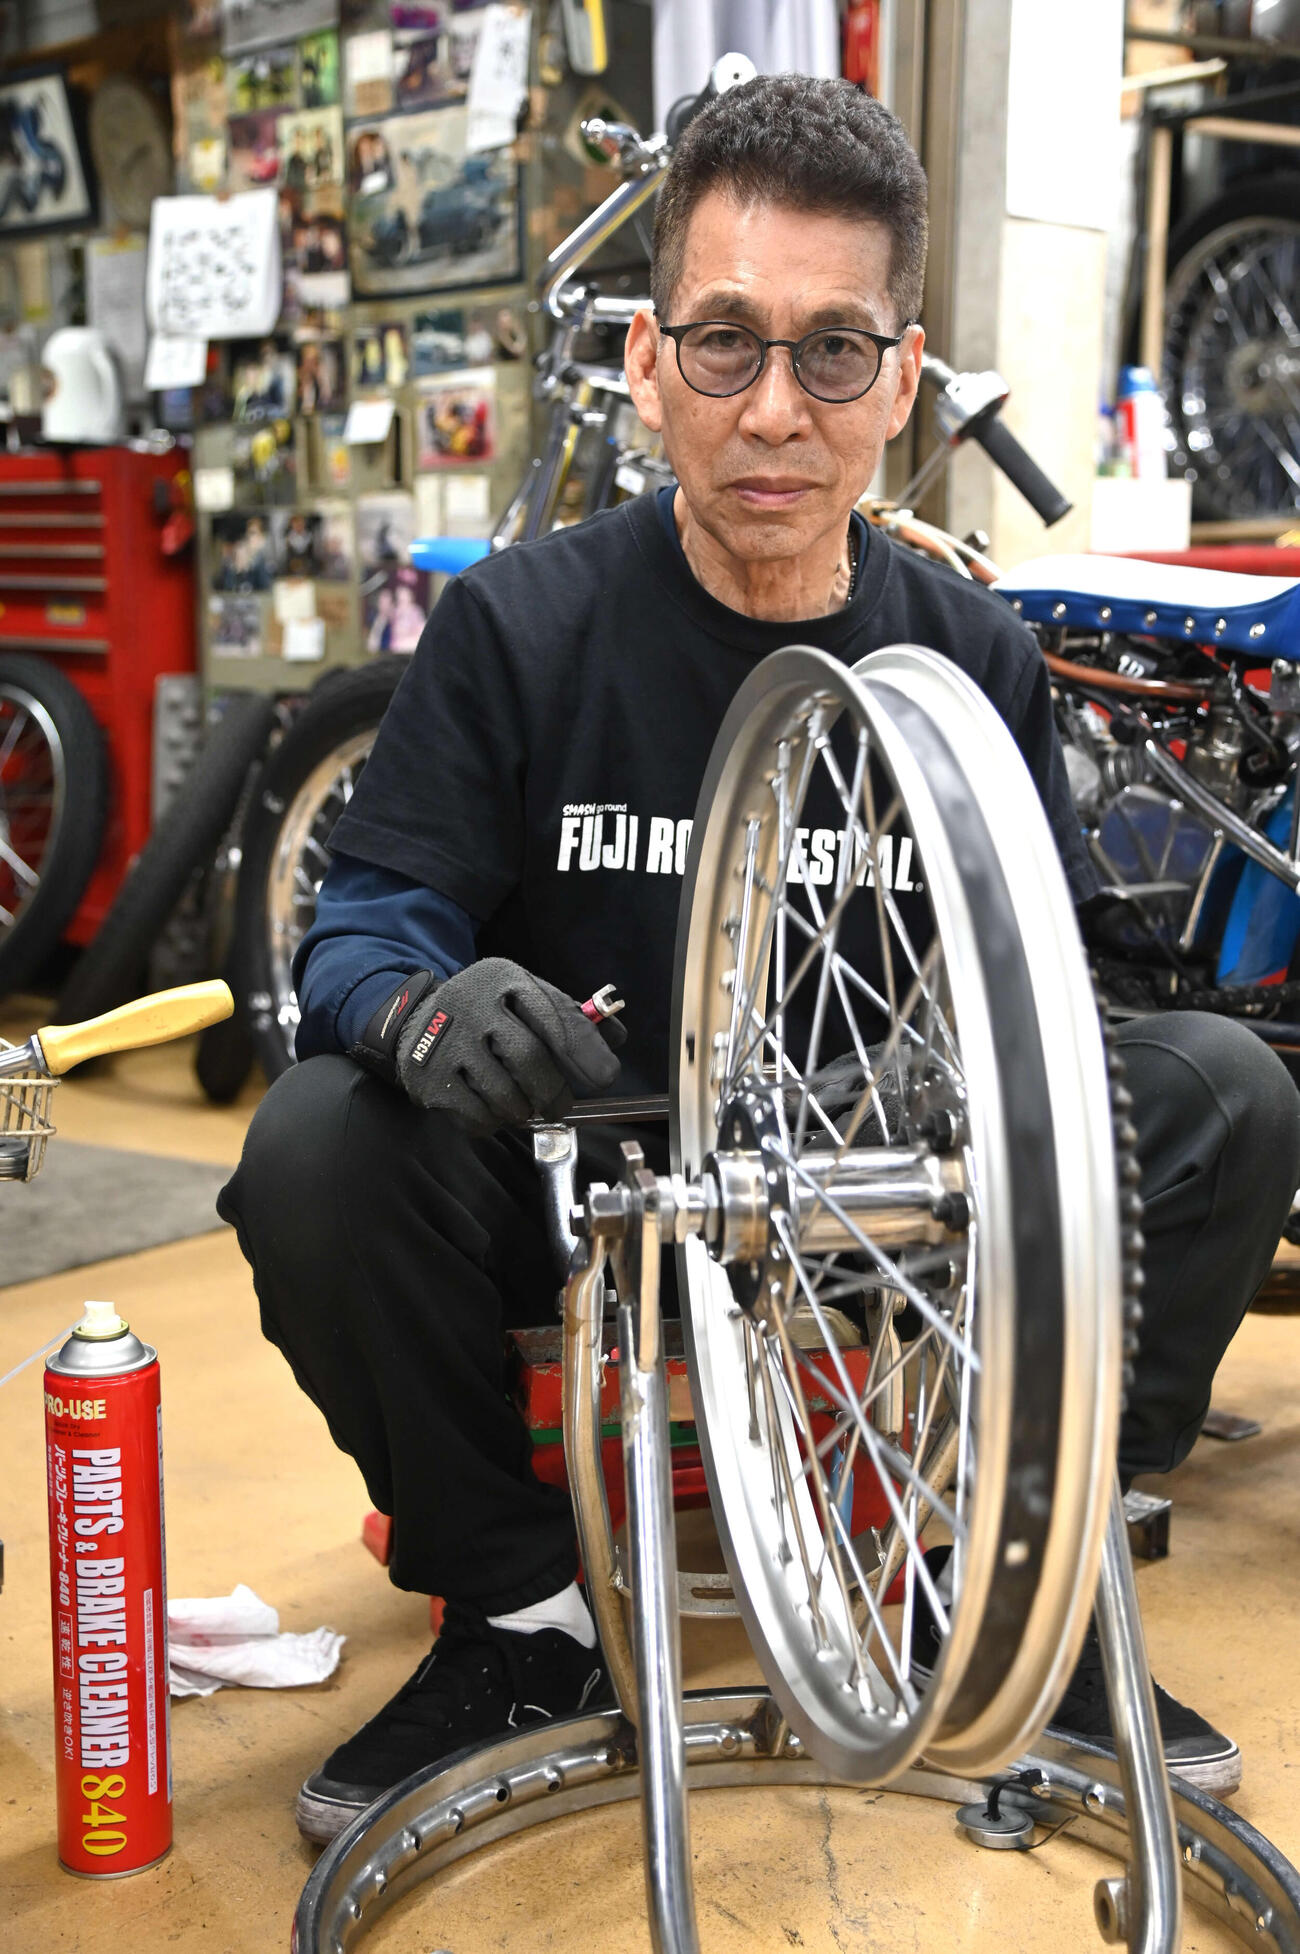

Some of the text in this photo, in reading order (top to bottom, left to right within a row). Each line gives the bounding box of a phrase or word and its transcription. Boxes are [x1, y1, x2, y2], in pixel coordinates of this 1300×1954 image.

[563, 803, 628, 816] SMASH go round
[557, 813, 639, 872] FUJI
[646, 816, 694, 875] RO
[72, 1447, 130, 1856] PARTS & BRAKE CLEANER 840
